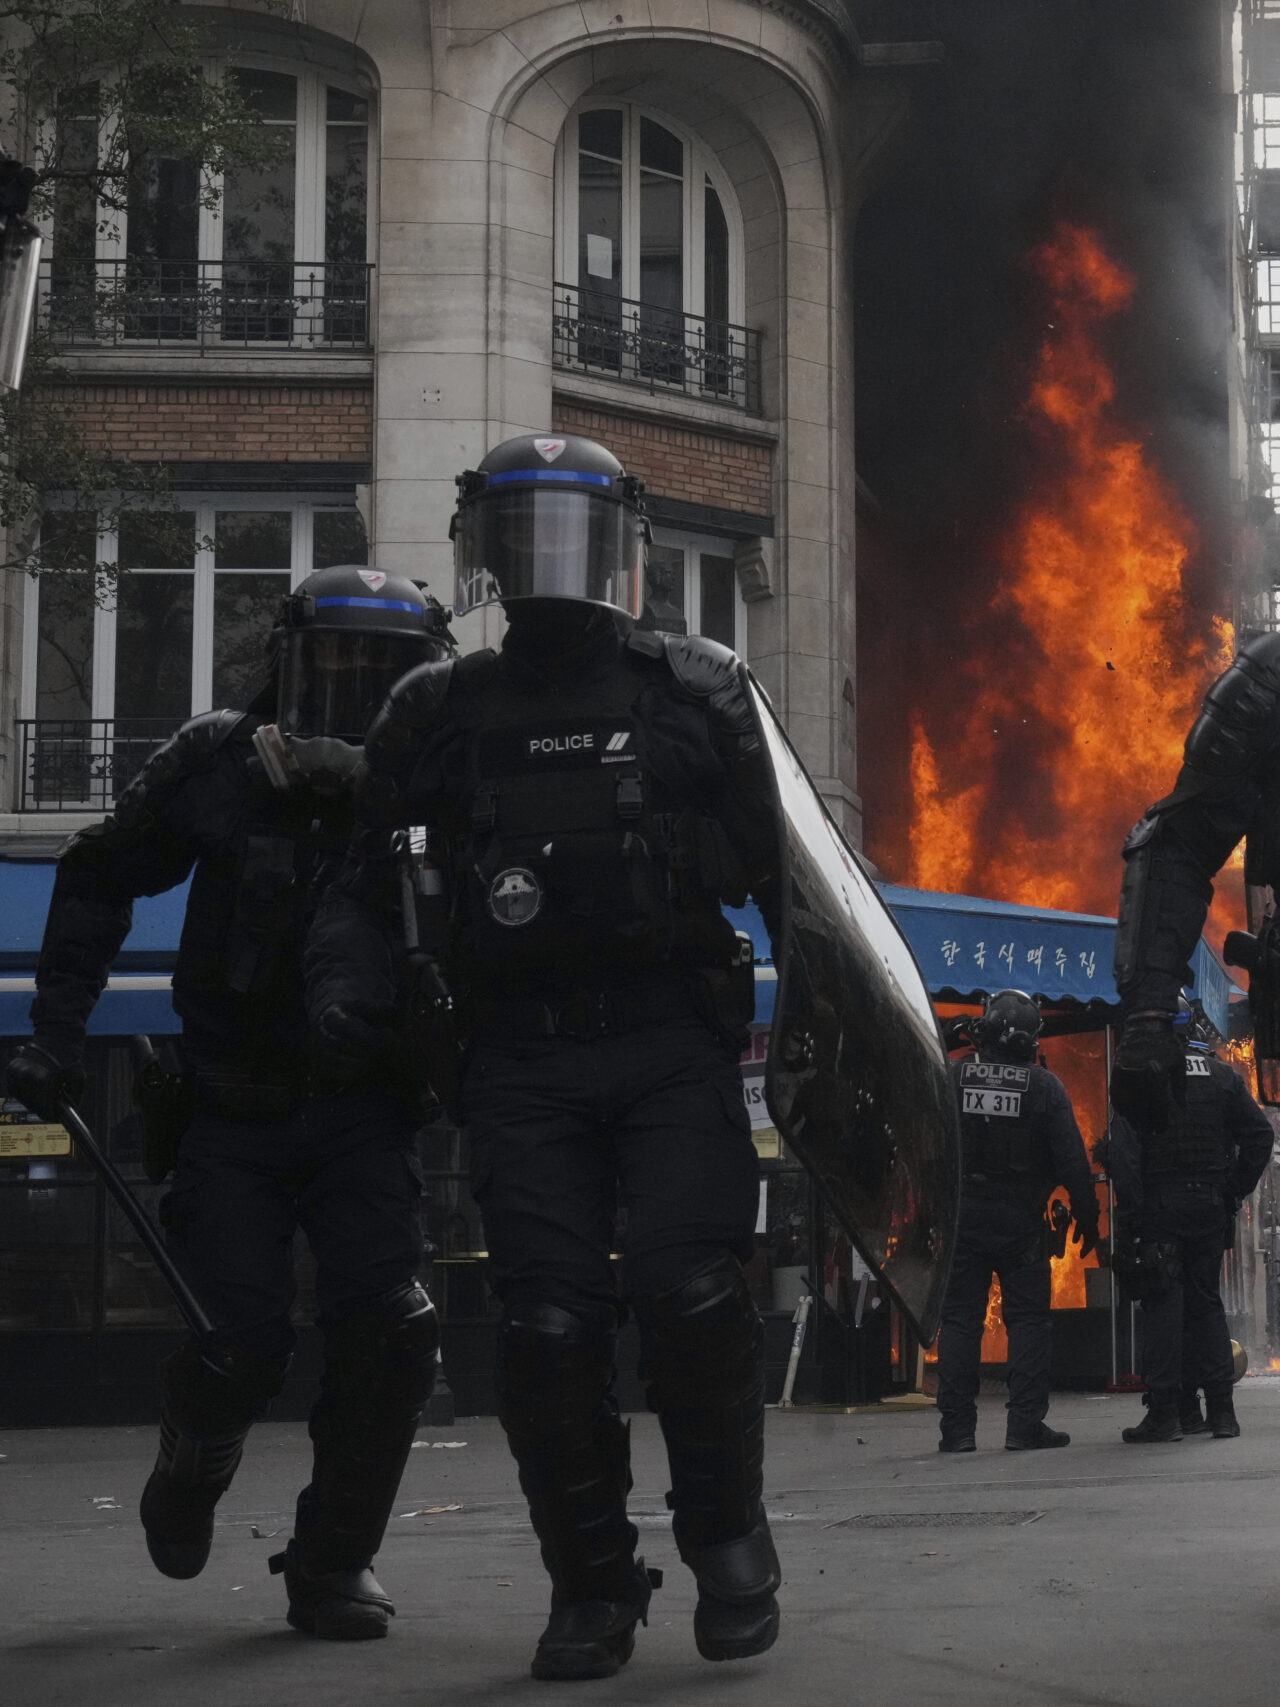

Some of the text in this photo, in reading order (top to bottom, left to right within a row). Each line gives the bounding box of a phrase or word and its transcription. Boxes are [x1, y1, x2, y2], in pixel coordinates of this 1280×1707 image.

[529, 734, 594, 754] POLICE
[965, 1065, 1026, 1082] POLICE
[965, 1092, 1020, 1112] TX 311
